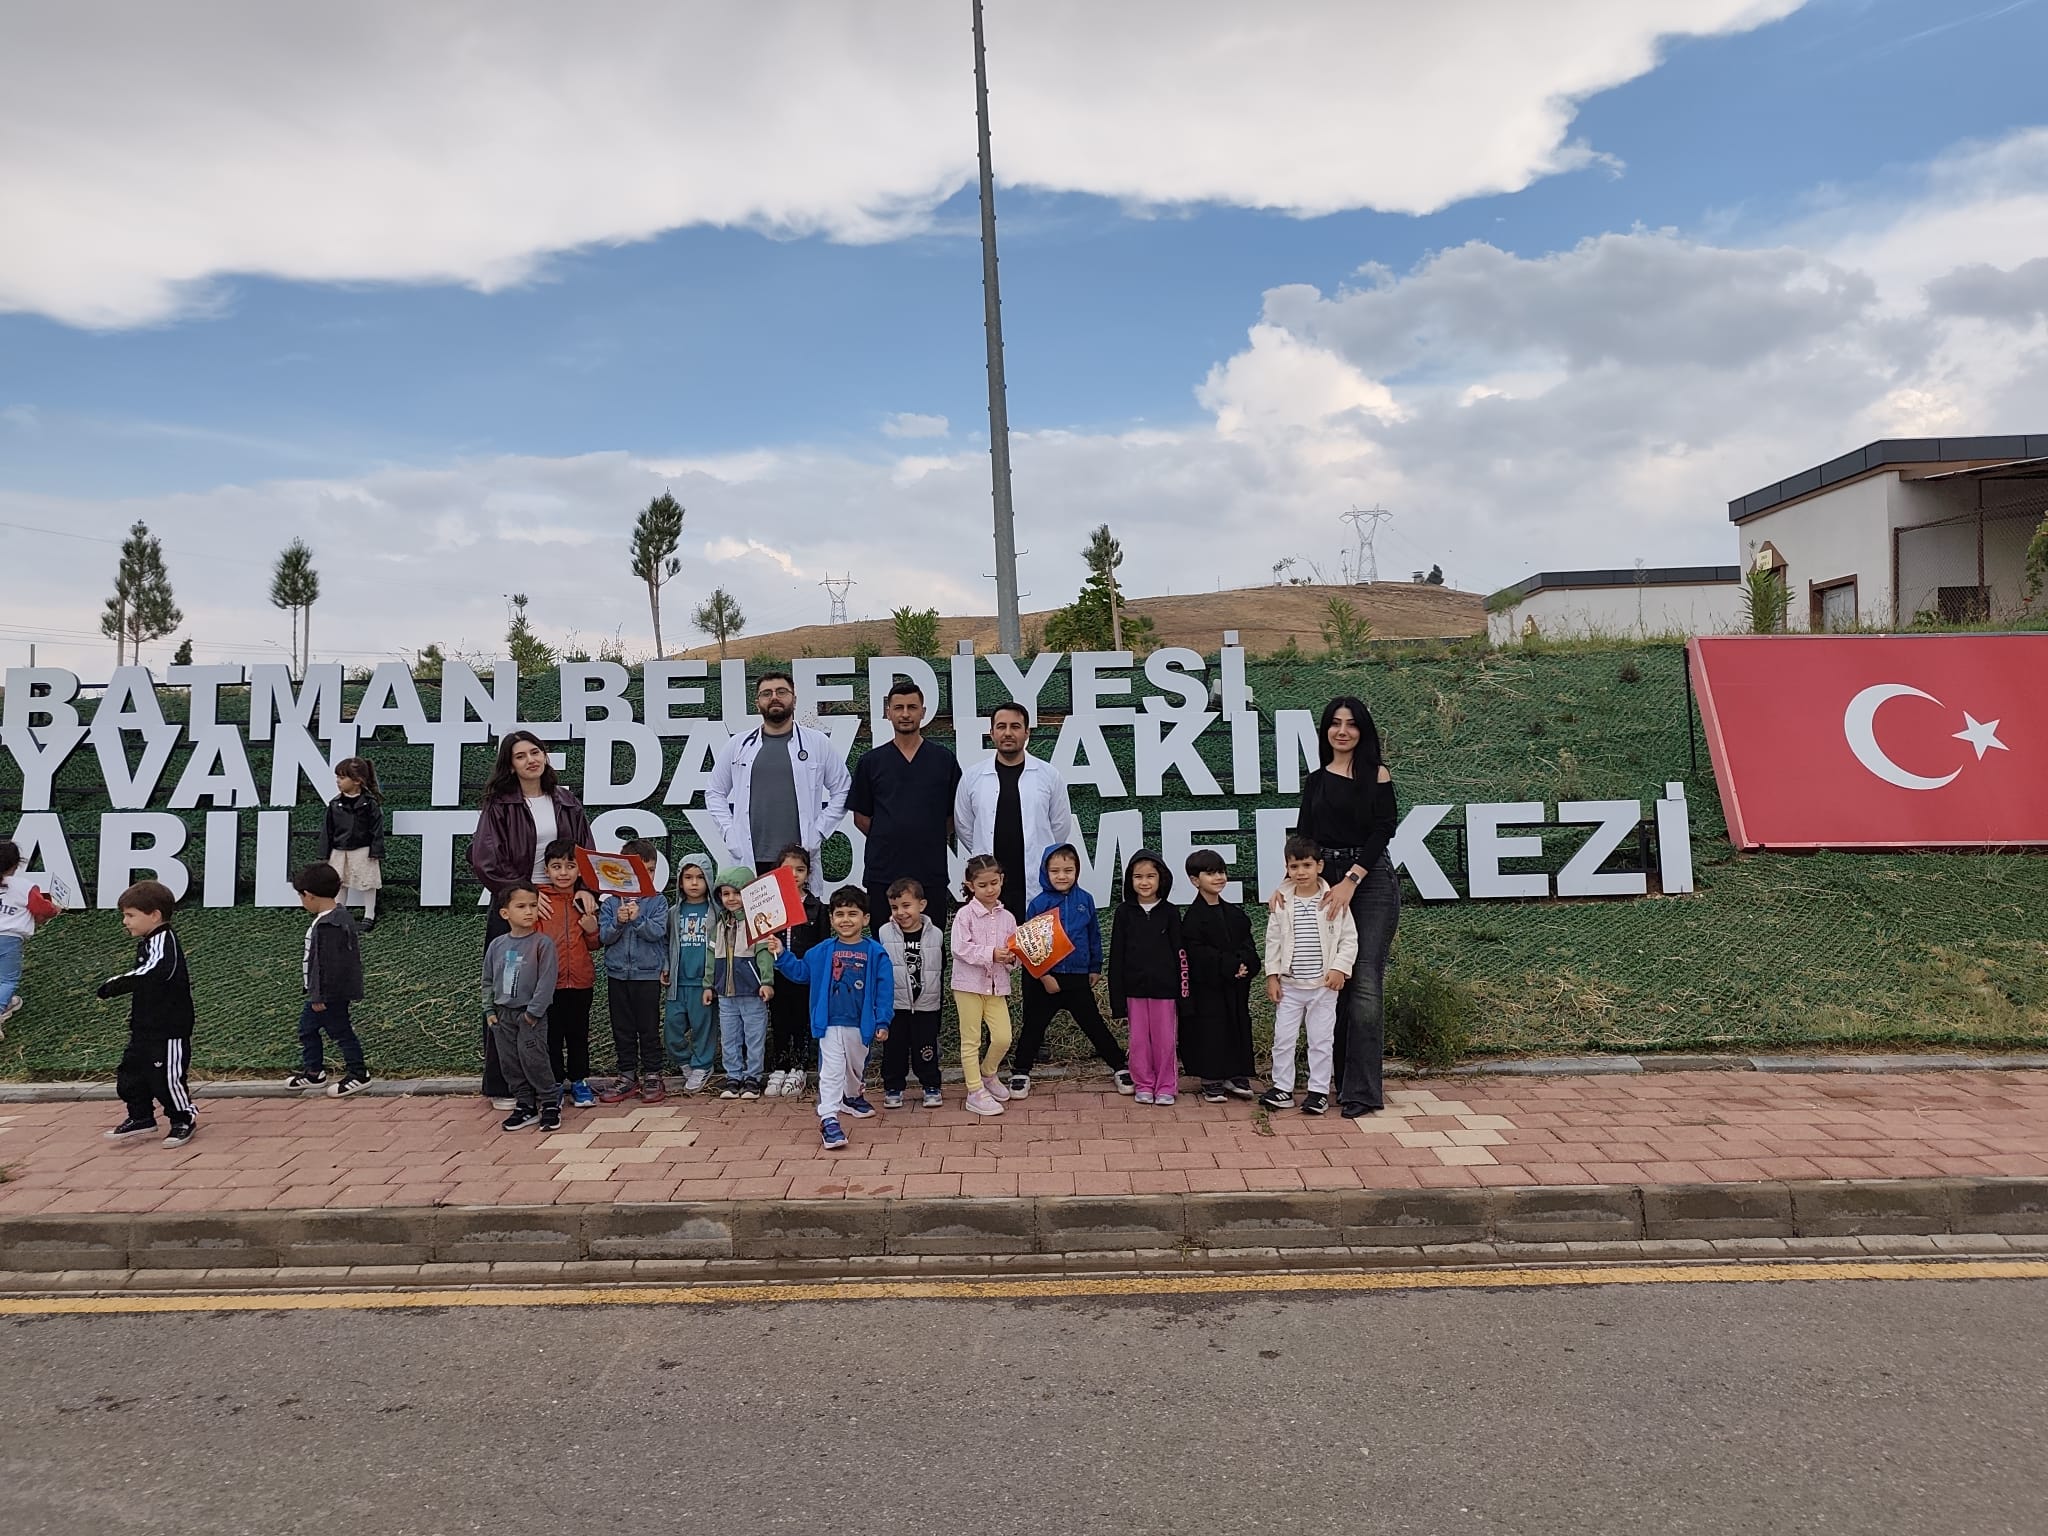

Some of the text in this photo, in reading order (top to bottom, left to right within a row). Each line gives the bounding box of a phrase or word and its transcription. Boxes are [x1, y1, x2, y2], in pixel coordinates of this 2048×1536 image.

[3, 630, 1247, 744] BATMAN BELEDİYESİ
[1178, 948, 1190, 998] adidas
